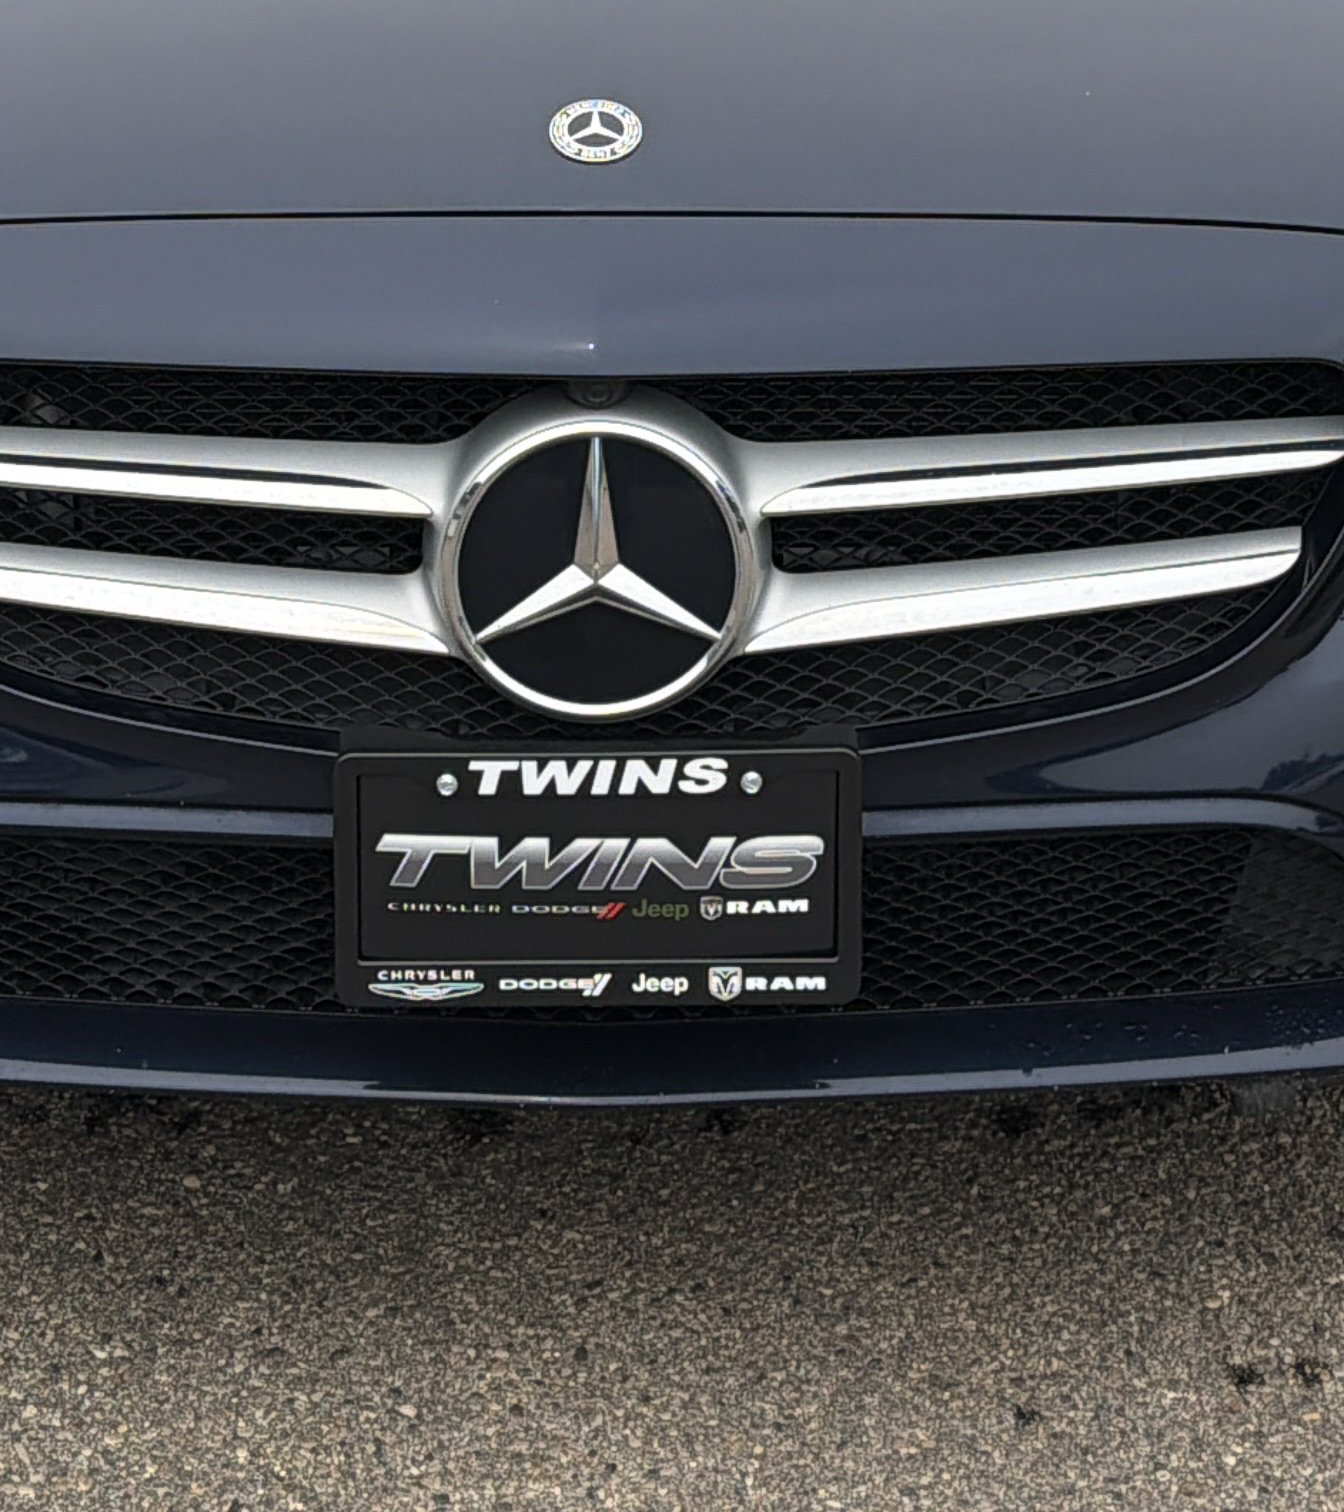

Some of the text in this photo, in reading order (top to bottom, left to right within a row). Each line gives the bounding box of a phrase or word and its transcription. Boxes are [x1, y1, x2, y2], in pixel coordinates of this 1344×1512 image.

[468, 757, 729, 795] TWINS
[375, 833, 825, 891] TWINS
[387, 898, 810, 921] CHRYSLER DODGE Jeep RAM
[377, 969, 476, 982] CHRYSLER
[499, 974, 827, 996] DODGE Jeep RAM
